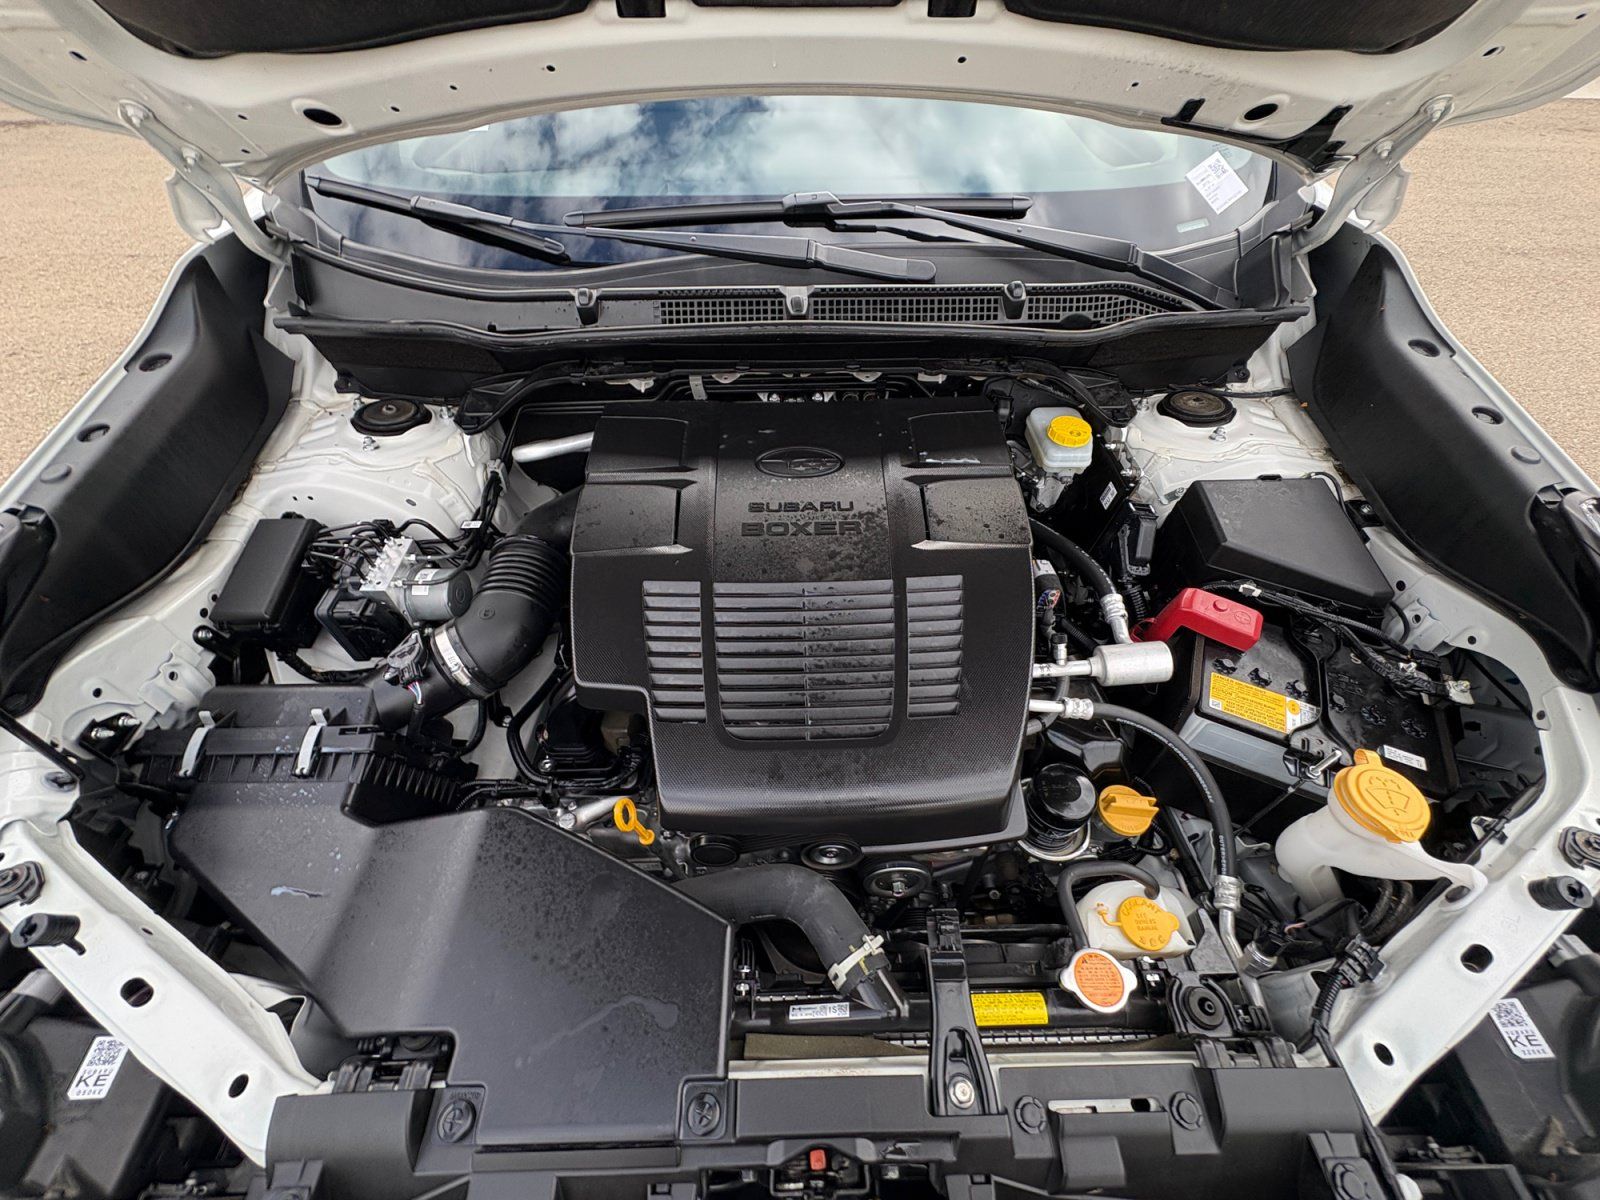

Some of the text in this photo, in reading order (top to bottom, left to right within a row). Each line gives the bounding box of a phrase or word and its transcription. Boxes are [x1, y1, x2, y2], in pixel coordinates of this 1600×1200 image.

[748, 501, 854, 513] SUBARU
[741, 521, 863, 537] BOXER
[1508, 1034, 1542, 1047] KE
[75, 1073, 110, 1087] KE
